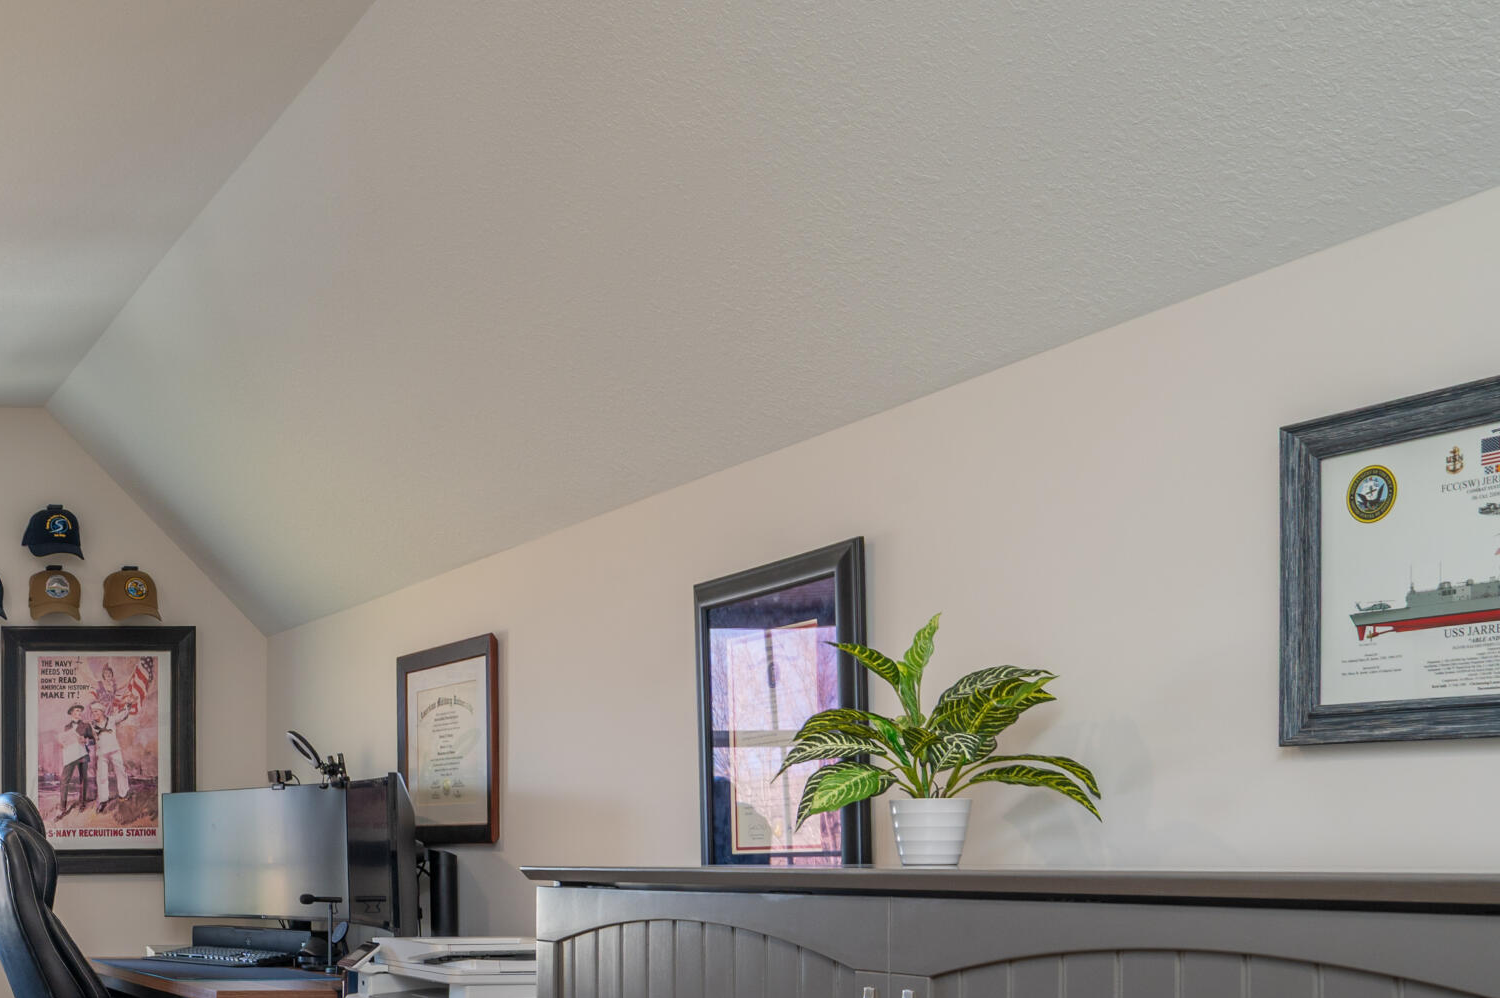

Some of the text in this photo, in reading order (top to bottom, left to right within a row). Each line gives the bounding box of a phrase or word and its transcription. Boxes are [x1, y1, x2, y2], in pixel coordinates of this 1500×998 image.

[1482, 474, 1500, 485] JER
[1444, 627, 1465, 639] USS
[40, 691, 65, 699] MAKE
[79, 829, 124, 837] RECRUITING
[126, 828, 157, 837] STATION
